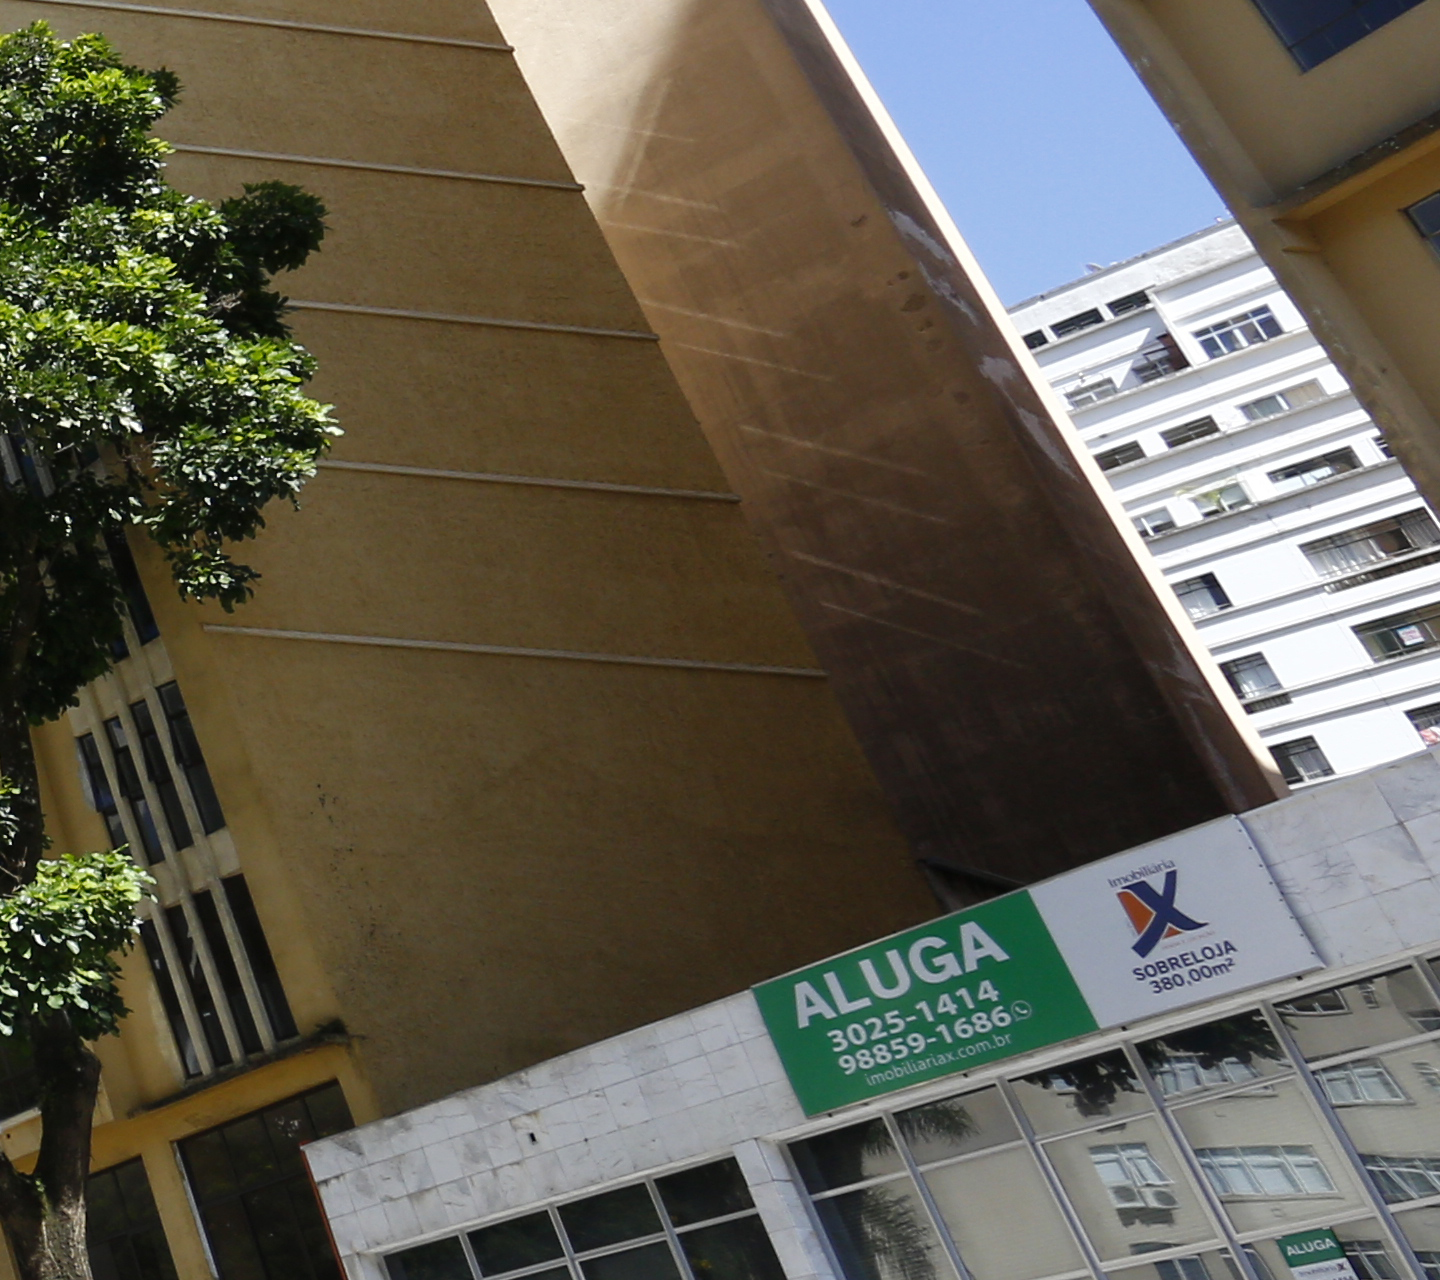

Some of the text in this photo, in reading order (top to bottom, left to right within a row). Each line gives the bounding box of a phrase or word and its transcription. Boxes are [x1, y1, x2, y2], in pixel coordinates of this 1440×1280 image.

[794, 921, 1011, 1029] ALUGA
[1132, 940, 1238, 981] SOBRELOJA
[827, 979, 999, 1053] 3025-1414
[838, 1005, 1012, 1076] 98859-1686
[866, 1032, 1012, 1087] imobiliariax.com.br
[1286, 1238, 1337, 1256] ALUGA
